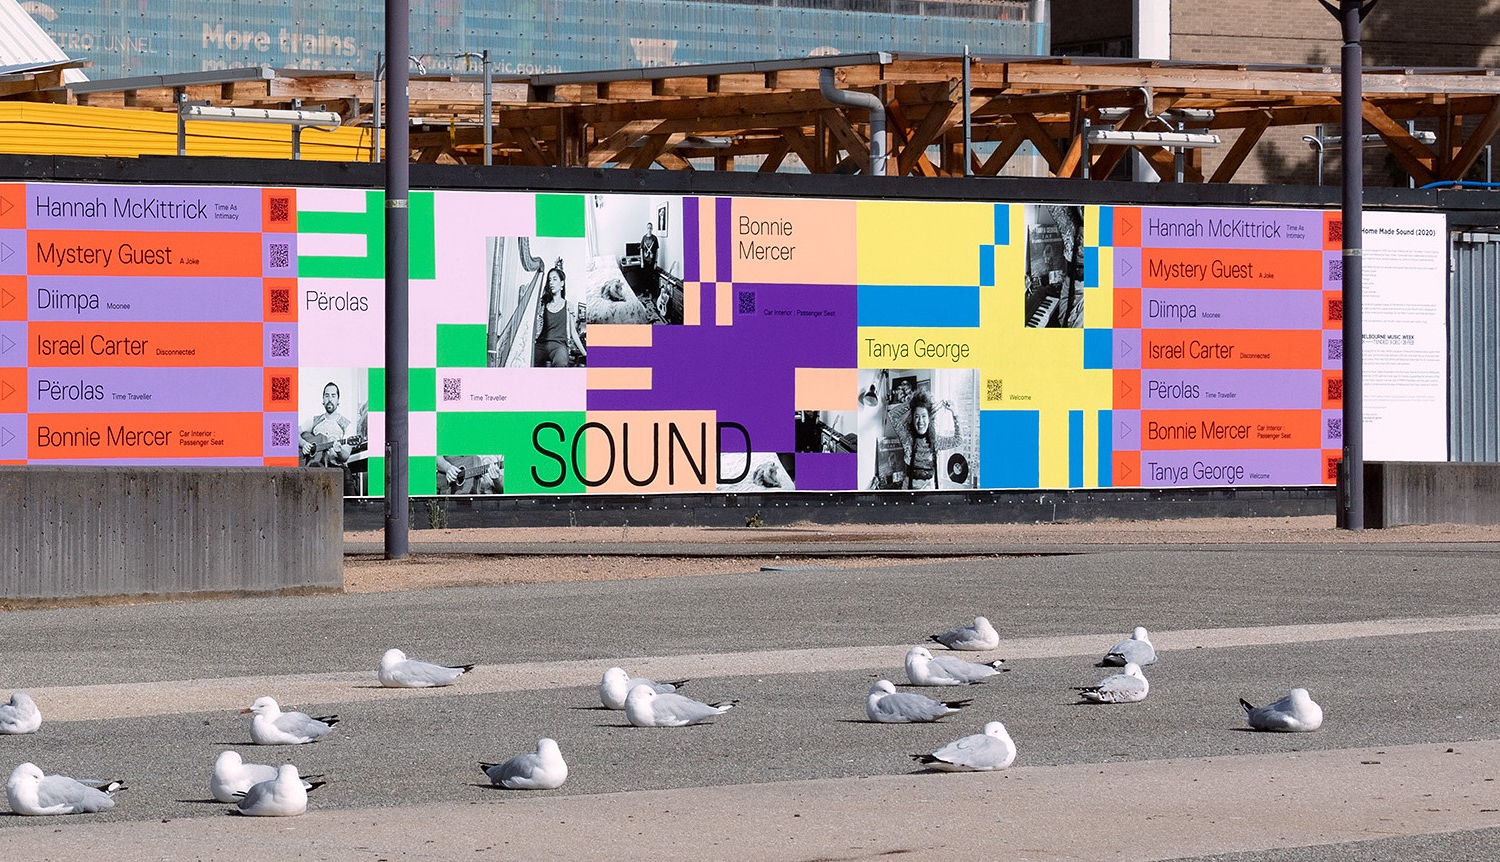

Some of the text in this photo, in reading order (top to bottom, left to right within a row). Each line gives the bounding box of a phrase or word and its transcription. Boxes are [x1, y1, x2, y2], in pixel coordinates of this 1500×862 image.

[202, 22, 363, 63] More trains,
[36, 196, 208, 219] Hannah McKittrick
[739, 216, 792, 236] Bonnie
[1149, 218, 1281, 238] Hannah McKittrick
[37, 242, 172, 268] Mystery Guest
[739, 240, 796, 260] Mercer
[1149, 259, 1253, 281] Mystery Guest
[38, 288, 99, 314] Diimpa
[306, 290, 368, 312] Përolas
[1149, 299, 1196, 322] Diimpa
[797, 309, 823, 317] Passenger
[38, 334, 148, 356] Israel Carter
[865, 338, 970, 363] Tanya George
[1149, 340, 1235, 359] Israel Carter
[38, 380, 104, 400] Përolas
[1149, 380, 1200, 399] Përolas
[38, 426, 172, 447] Bonnie Mercer
[1148, 421, 1252, 440] Bonnie Mercer
[179, 439, 209, 448] Passenger
[531, 422, 752, 488] SOUND
[1148, 461, 1244, 485] Tanya George
